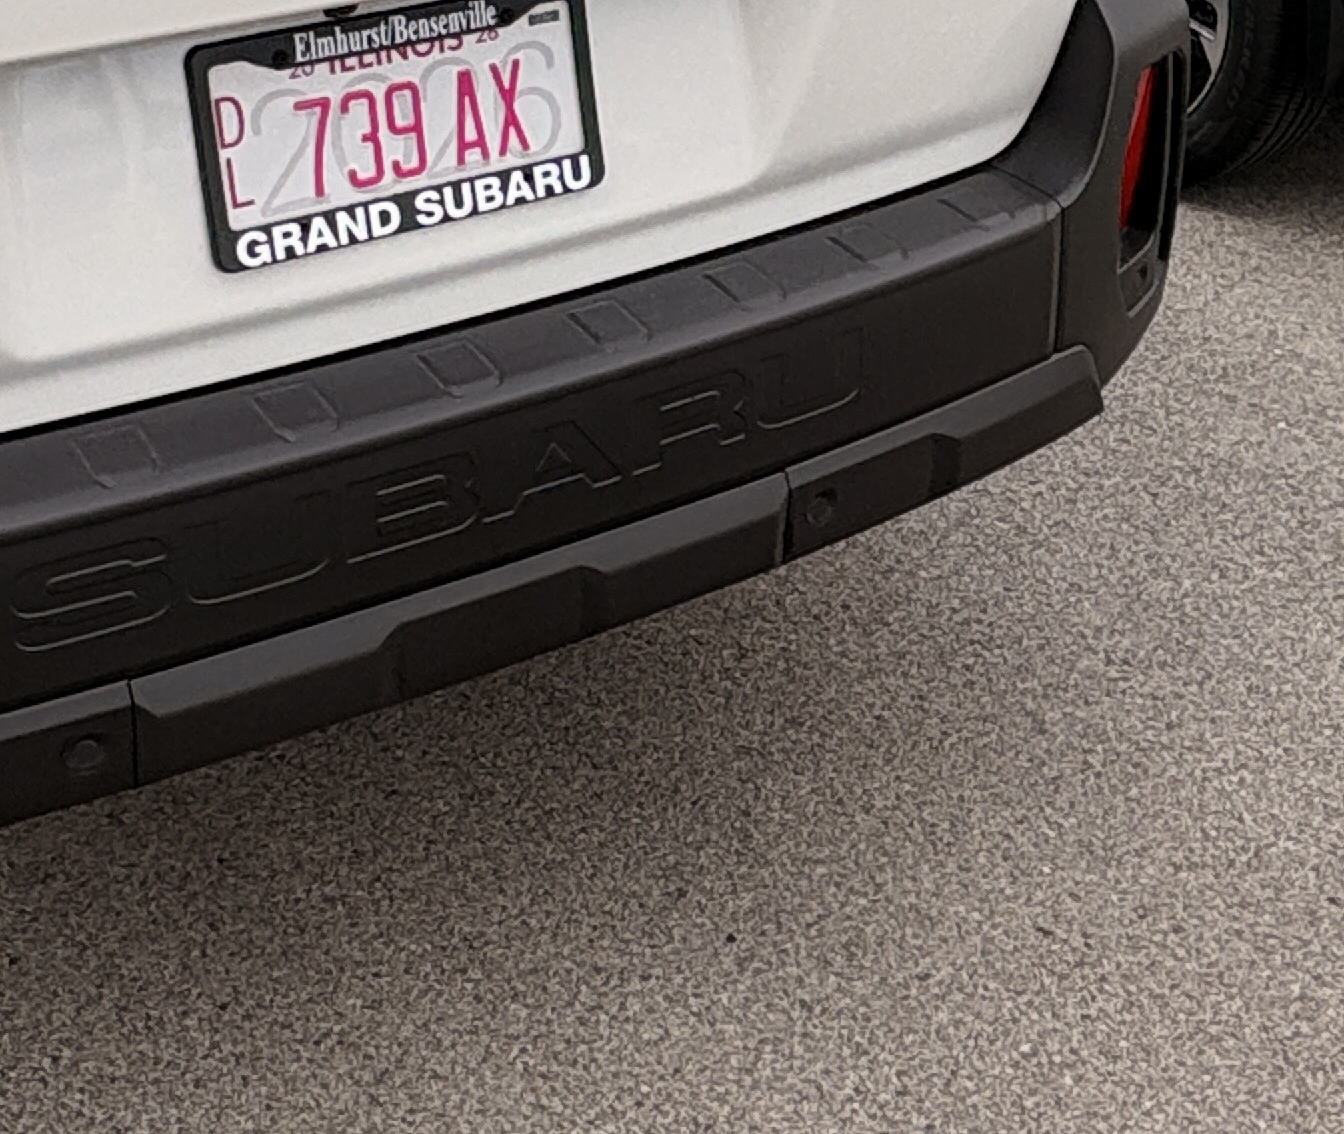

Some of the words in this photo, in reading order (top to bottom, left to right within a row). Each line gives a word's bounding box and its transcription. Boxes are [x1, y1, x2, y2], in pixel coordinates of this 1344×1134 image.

[294, 80, 428, 198] 739
[455, 58, 531, 168] AX
[235, 200, 403, 269] GRAND
[414, 154, 592, 227] SUBARU
[9, 326, 866, 652] SUBARU
